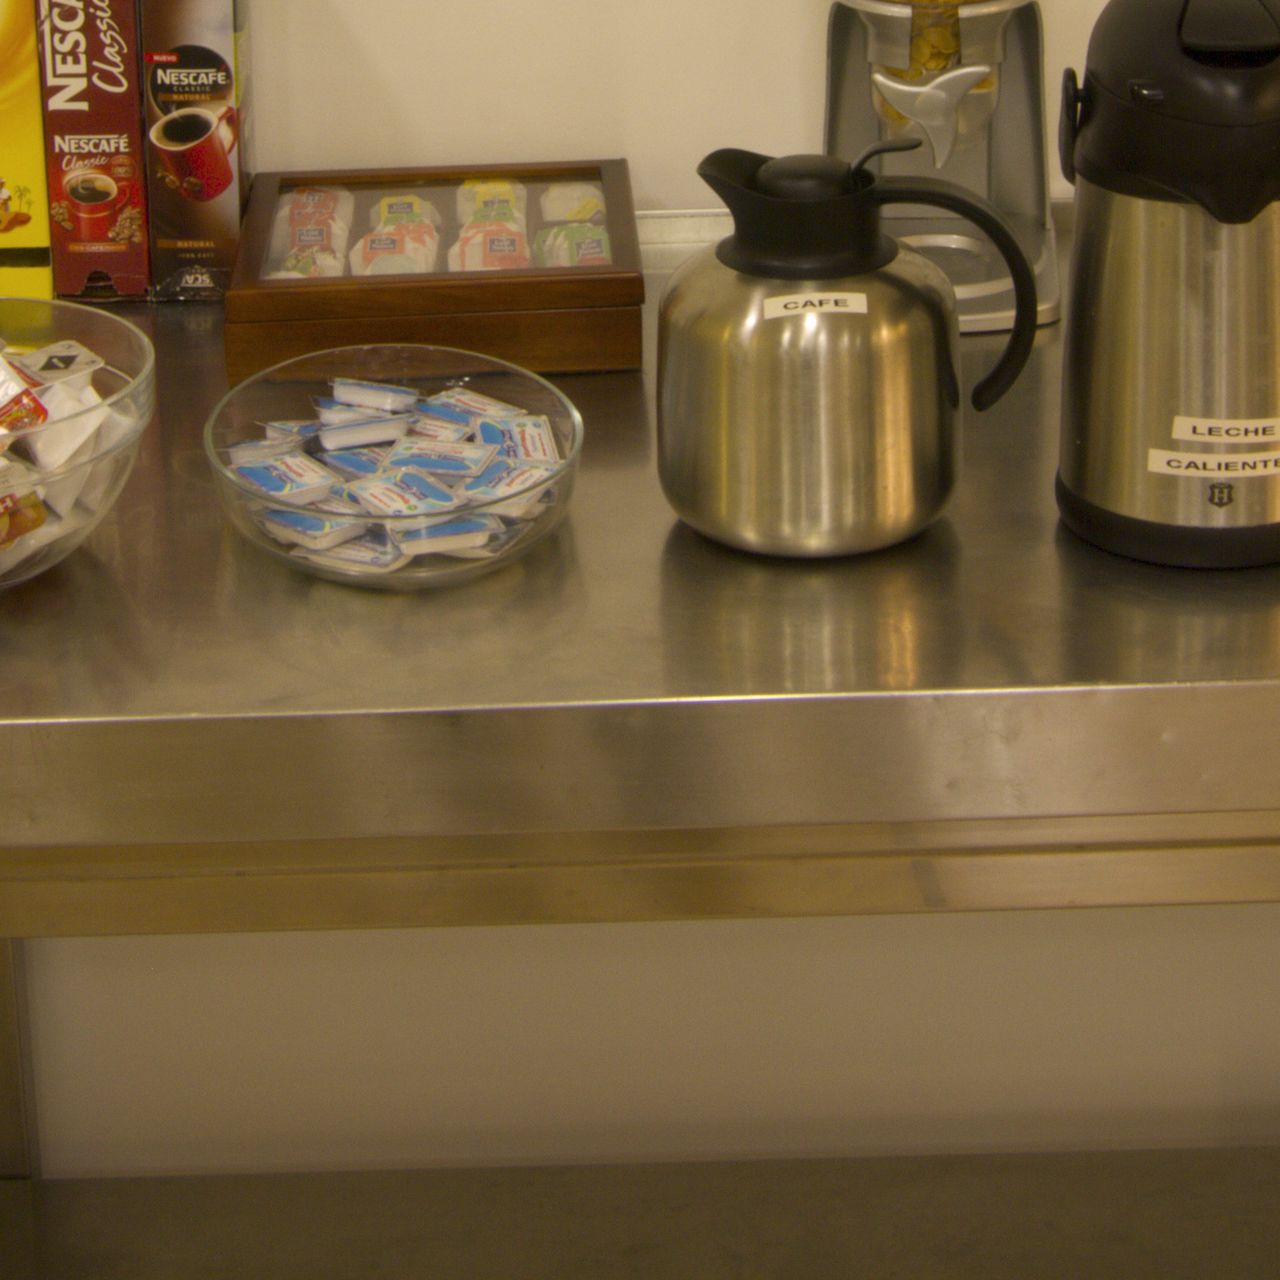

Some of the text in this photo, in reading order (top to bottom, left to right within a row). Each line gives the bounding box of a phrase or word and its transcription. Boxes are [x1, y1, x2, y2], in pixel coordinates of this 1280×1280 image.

[54, 134, 130, 153] NESCAFÉ
[62, 154, 109, 171] Classic
[783, 298, 849, 310] CAFE
[1191, 425, 1276, 437] LECHE
